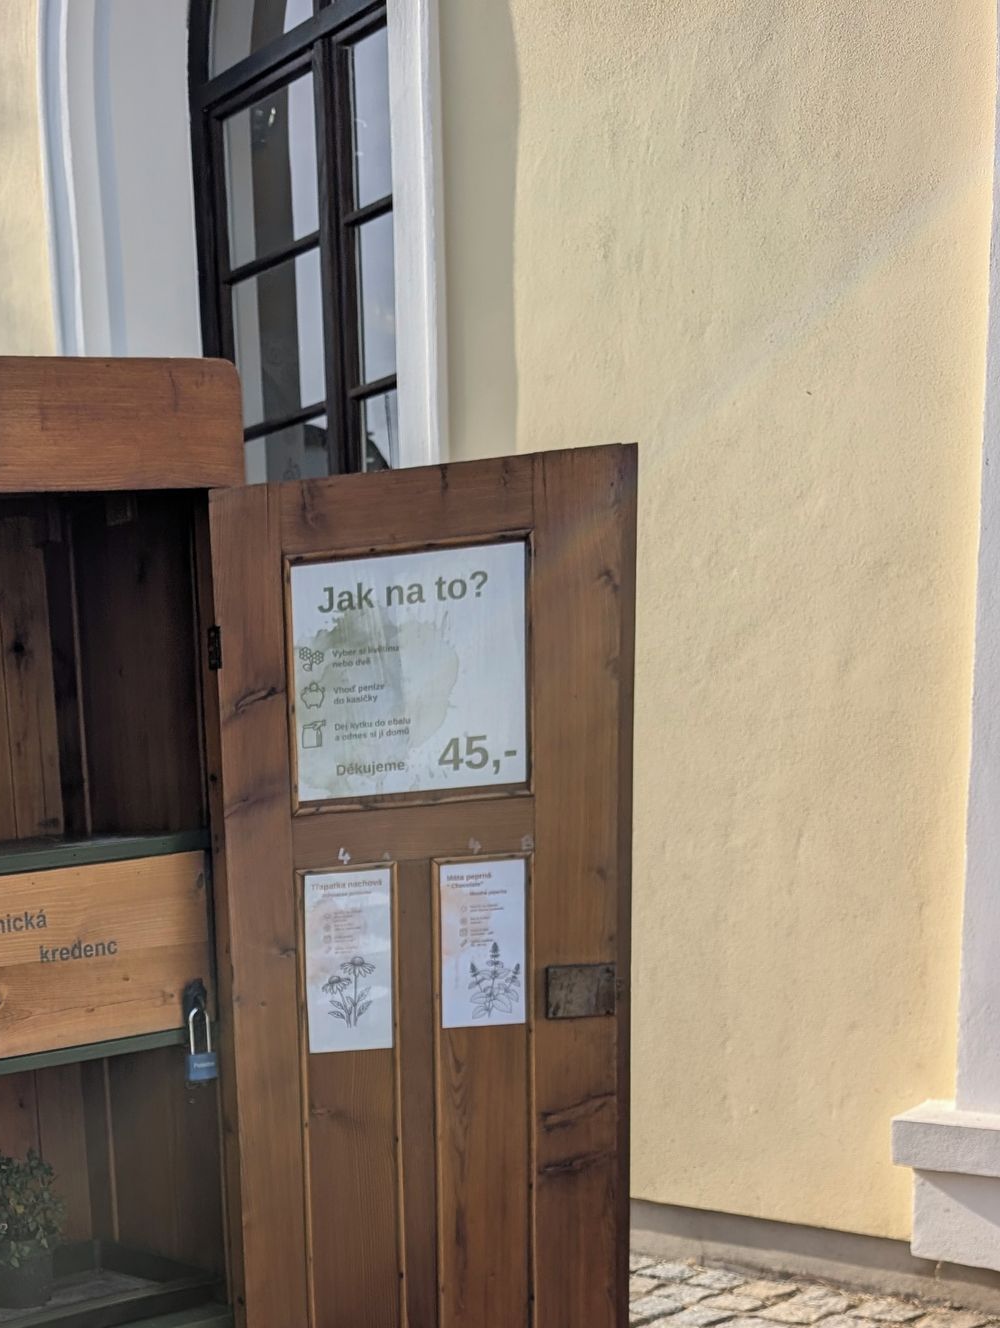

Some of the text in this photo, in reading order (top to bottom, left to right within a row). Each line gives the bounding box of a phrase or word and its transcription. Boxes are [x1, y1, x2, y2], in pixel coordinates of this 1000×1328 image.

[317, 569, 489, 614] Jak na to?
[332, 657, 371, 668] nebo dvě
[333, 697, 344, 705] do
[374, 719, 386, 728] do
[436, 734, 518, 776] 45,-
[337, 847, 351, 865] 4
[39, 937, 119, 964] kredenc
